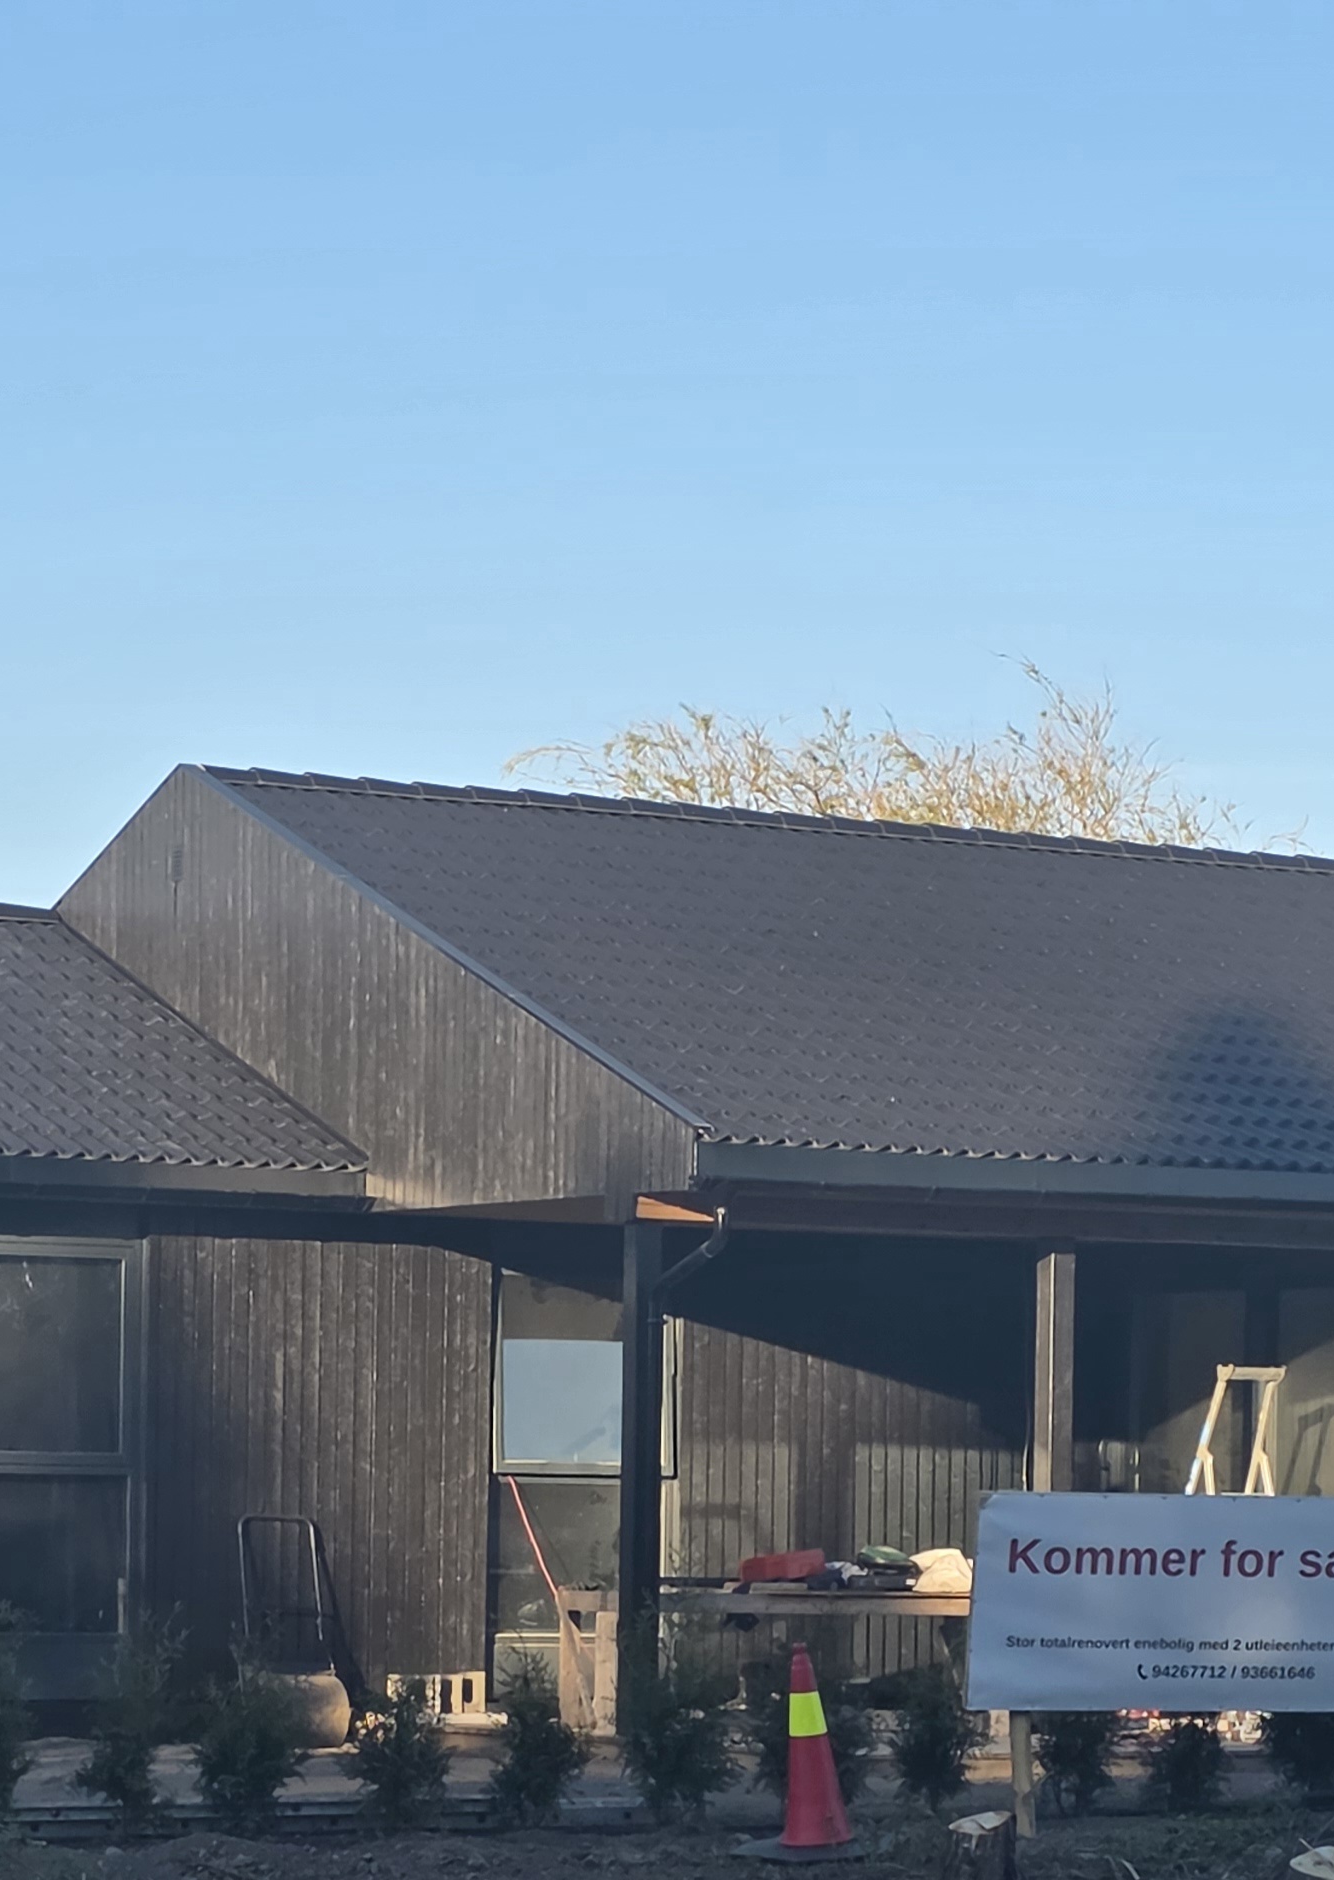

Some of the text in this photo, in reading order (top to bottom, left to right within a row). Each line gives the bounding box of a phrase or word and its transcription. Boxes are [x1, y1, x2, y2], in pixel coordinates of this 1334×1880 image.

[1007, 1537, 1206, 1578] Kommer
[1220, 1540, 1285, 1578] for
[1006, 1635, 1036, 1648] Stor
[1040, 1636, 1130, 1650] totalrenovert
[1134, 1637, 1194, 1653] enebolig
[1199, 1639, 1229, 1651] med
[1233, 1639, 1242, 1651] 2
[1245, 1639, 1334, 1652] utleieenheter
[1151, 1664, 1315, 1680] 94267712 / 93661646
